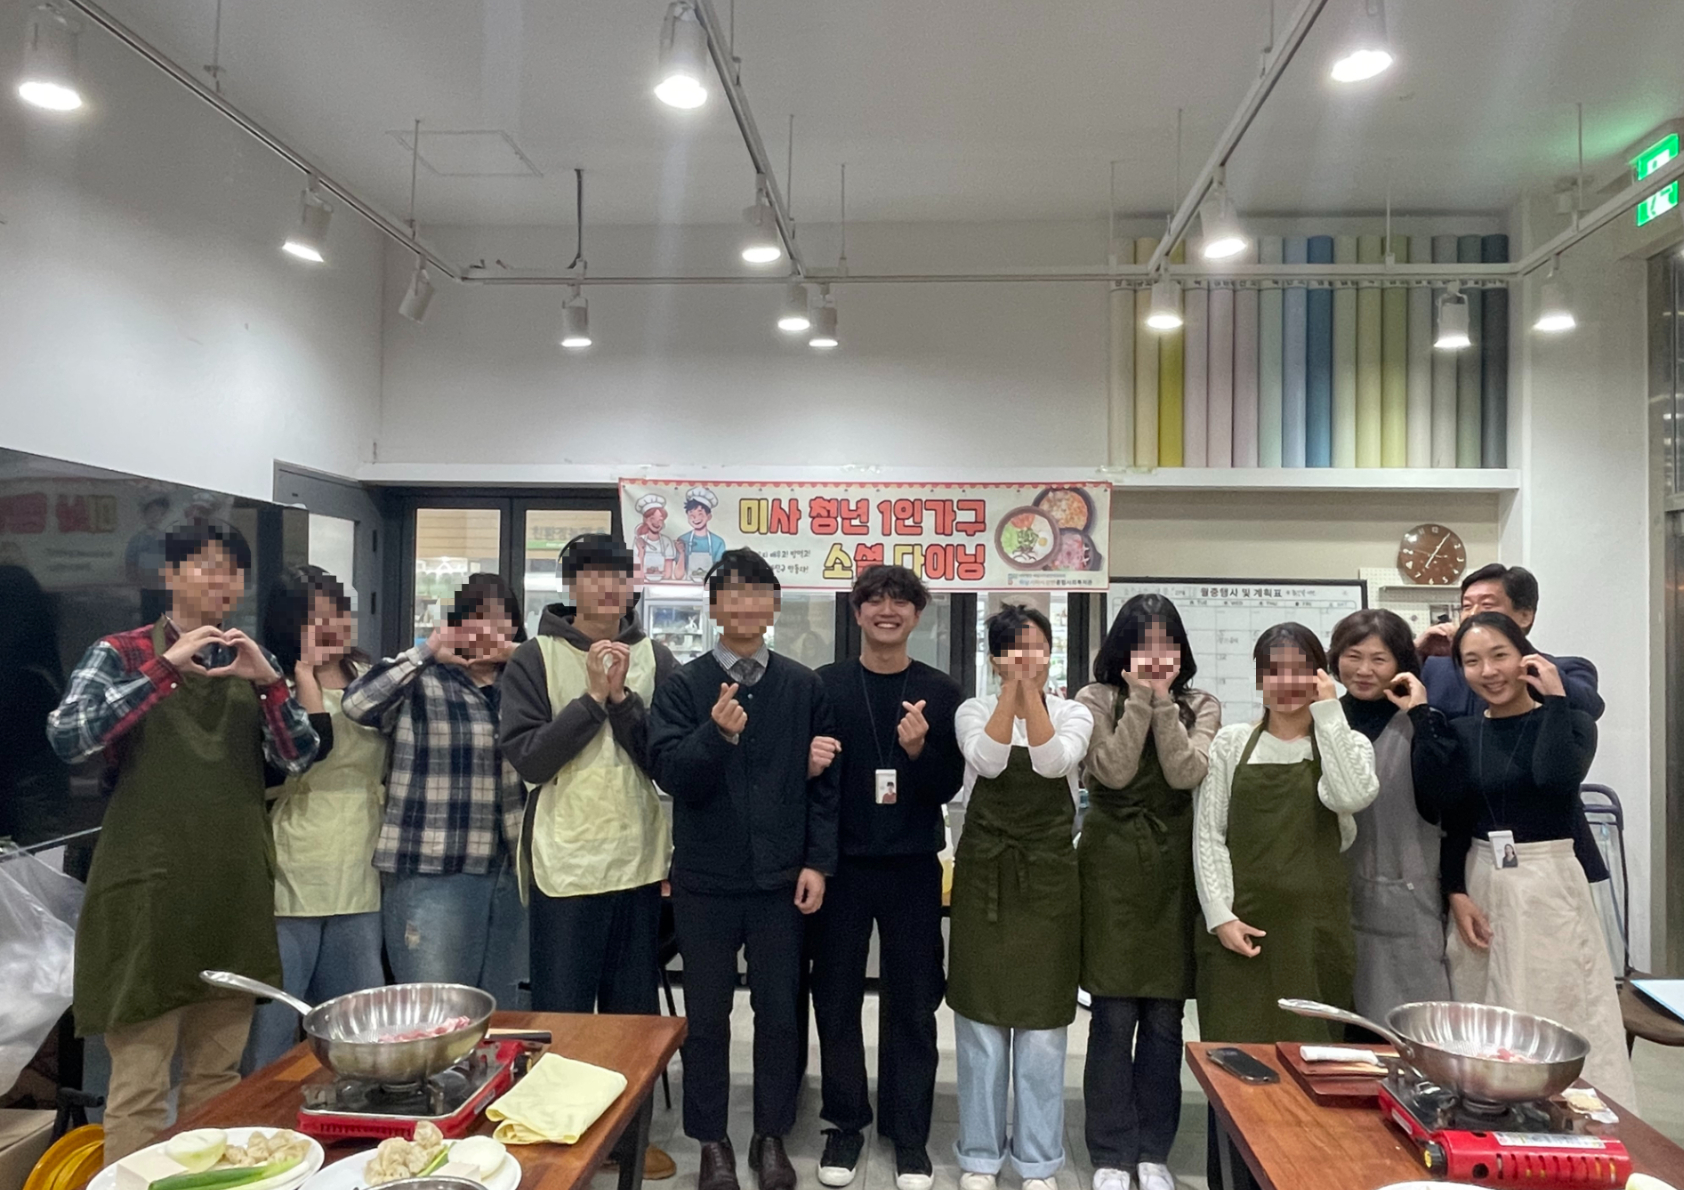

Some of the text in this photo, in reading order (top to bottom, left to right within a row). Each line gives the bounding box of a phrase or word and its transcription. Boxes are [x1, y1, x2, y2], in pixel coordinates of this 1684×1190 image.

[739, 496, 987, 537] 미사 청년 1인가구
[894, 543, 986, 580] 다이닝
[1200, 587, 1239, 598] 월중행사
[1242, 588, 1251, 598] 및
[1253, 588, 1283, 598] 계획표
